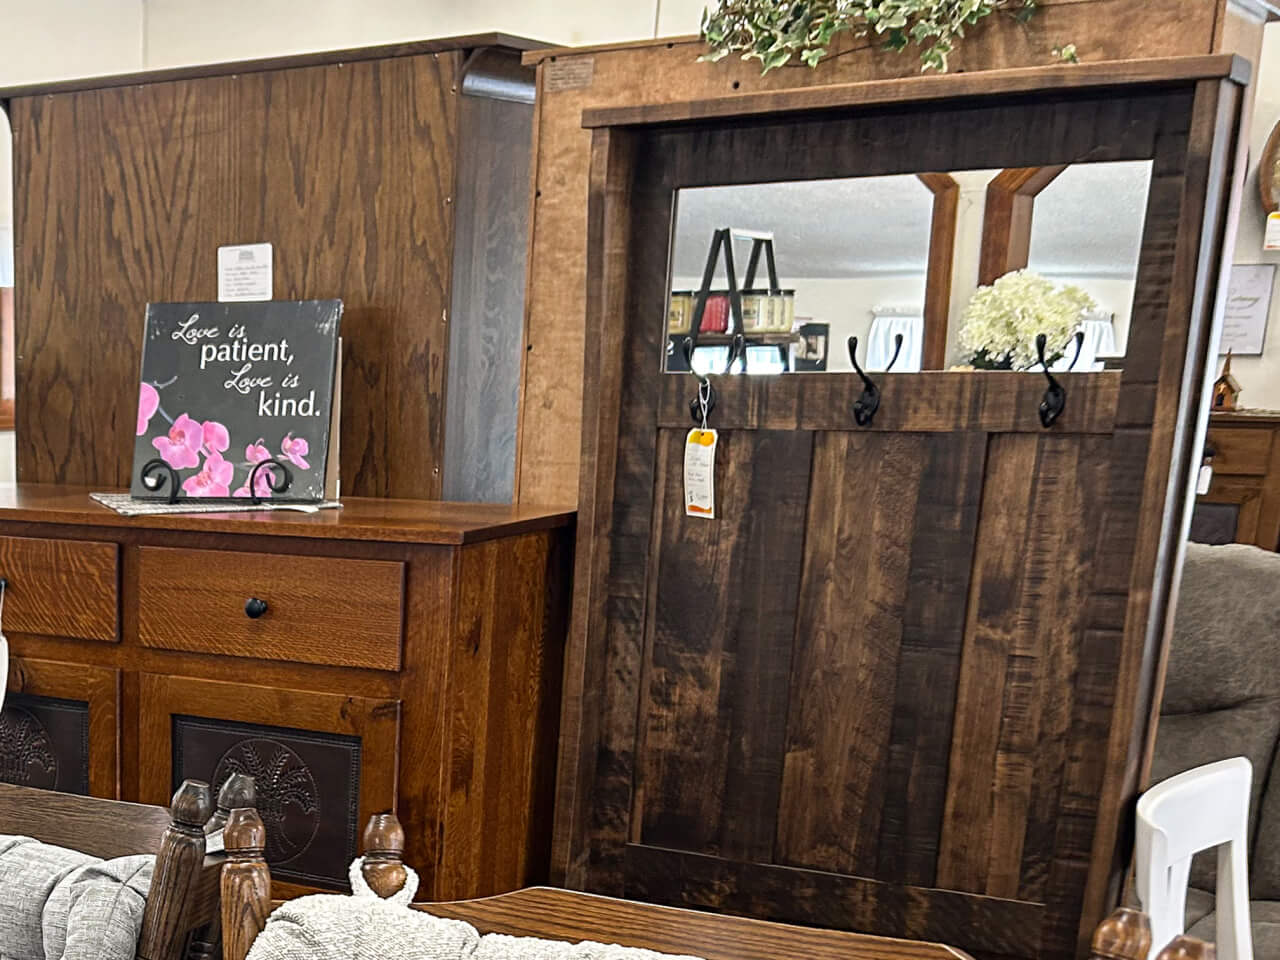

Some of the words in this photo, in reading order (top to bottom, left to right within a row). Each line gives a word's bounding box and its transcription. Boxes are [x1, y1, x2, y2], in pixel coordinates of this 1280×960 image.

[172, 313, 220, 345] Love
[228, 323, 247, 339] is
[200, 338, 294, 369] patient,
[224, 363, 273, 394] Love
[281, 372, 300, 388] is
[258, 390, 321, 417] kind.
